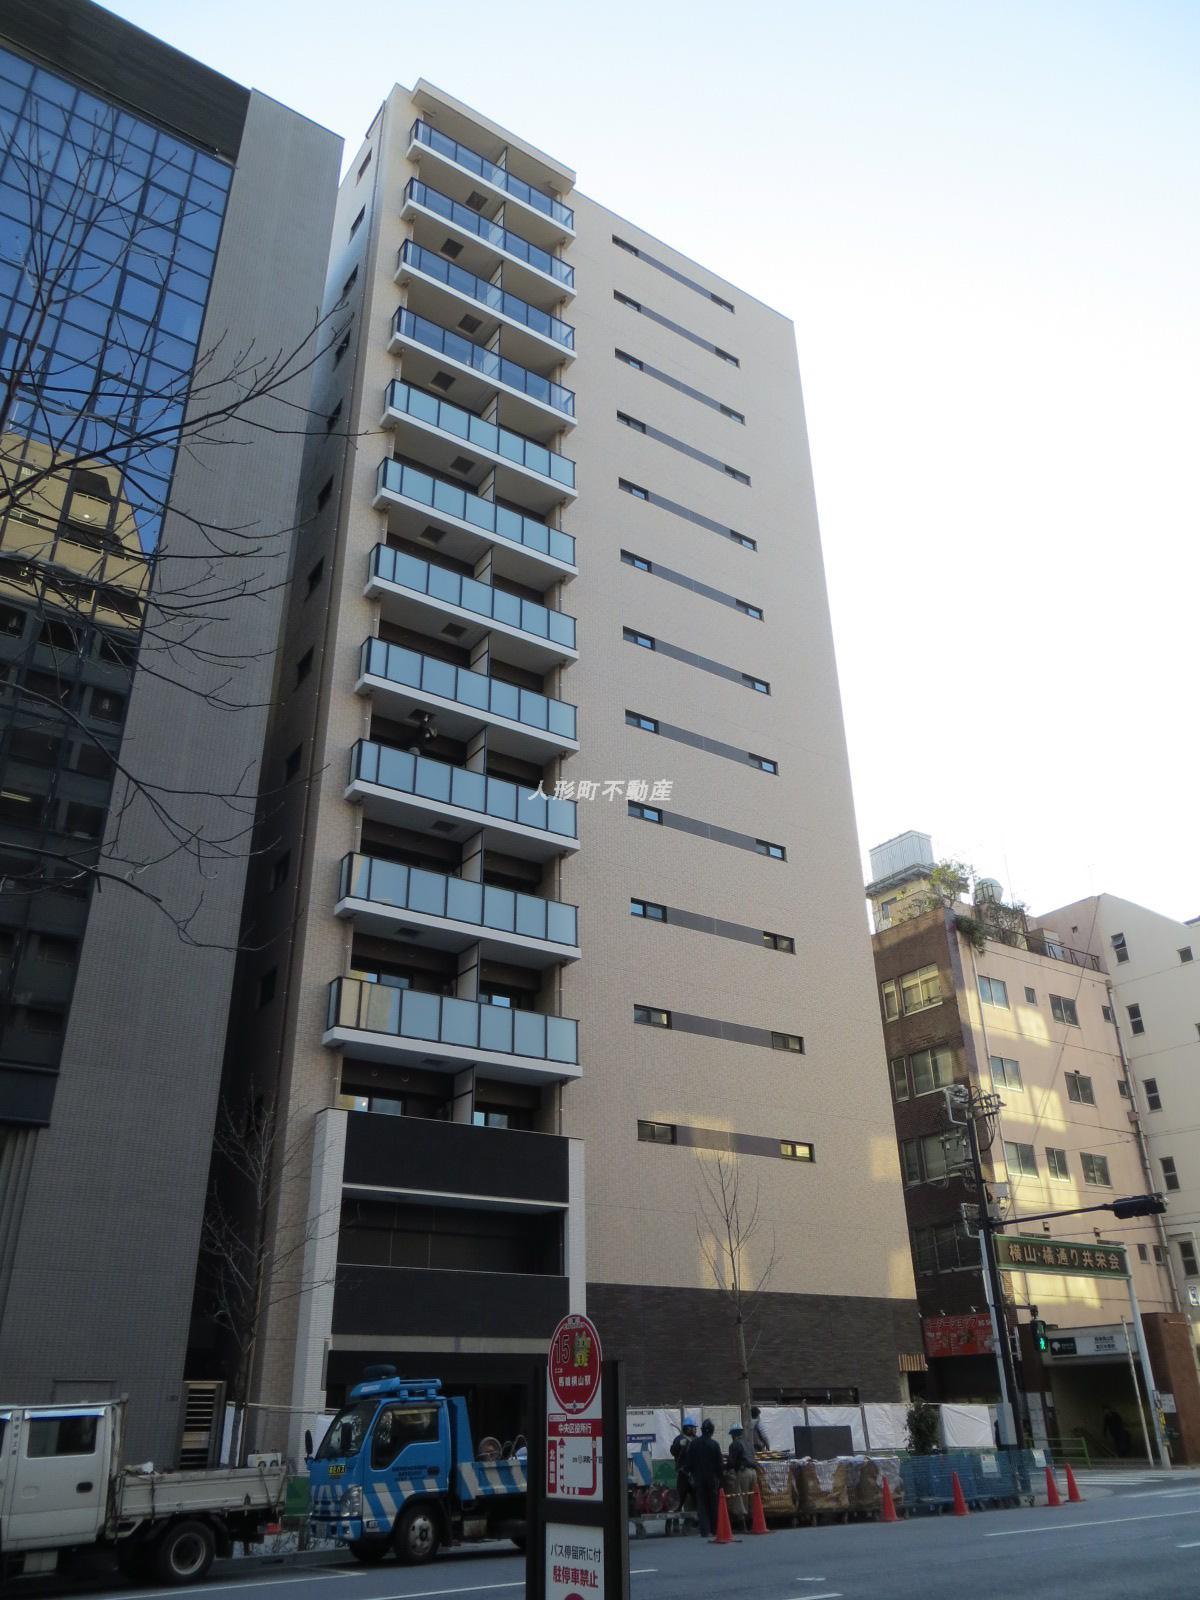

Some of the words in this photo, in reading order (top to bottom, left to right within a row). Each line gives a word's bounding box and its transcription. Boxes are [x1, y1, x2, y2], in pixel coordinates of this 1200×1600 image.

[555, 1334, 570, 1364] 15
[558, 1423, 592, 1434] 中央区役所行
[551, 1544, 601, 1563] バス停留所に付
[553, 1565, 599, 1588] 駐停車禁止
